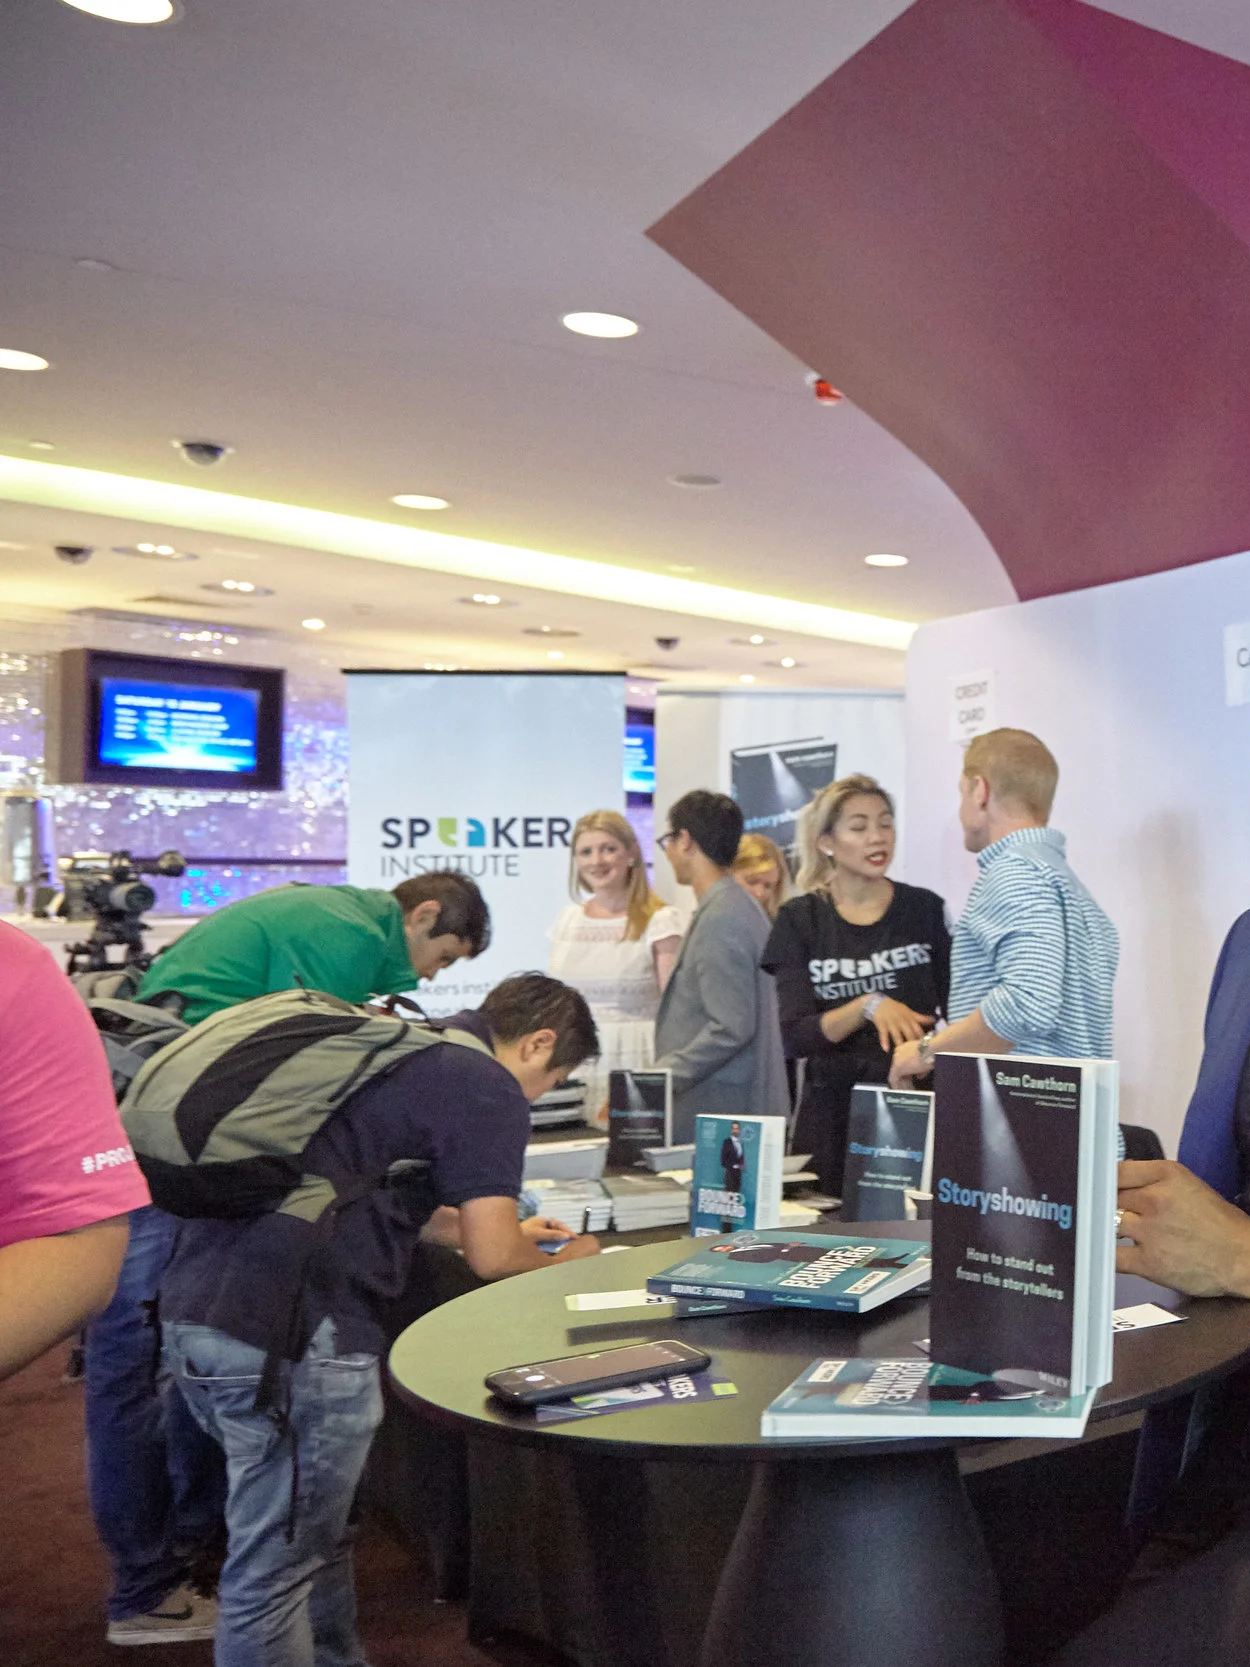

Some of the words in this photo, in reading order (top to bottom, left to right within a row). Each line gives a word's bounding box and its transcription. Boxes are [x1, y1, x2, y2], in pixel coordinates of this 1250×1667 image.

[381, 817, 571, 849] SPEAKER
[380, 853, 520, 877] INSTITUTE
[996, 1072, 1020, 1087] Sam
[1022, 1074, 1077, 1093] Cawthorn
[938, 1177, 1073, 1230] Storyshowing
[778, 1249, 848, 1287] BOUNCE
[800, 1245, 877, 1289] FORWARD
[966, 1247, 989, 1262] How
[991, 1253, 1003, 1265] to
[1004, 1256, 1034, 1272] stand
[1035, 1264, 1054, 1276] out
[956, 1266, 981, 1282] from
[983, 1272, 1000, 1286] the
[1002, 1278, 1064, 1300] storytellers
[667, 1373, 698, 1399] KERS
[883, 1362, 934, 1402] BOUNCE
[1038, 1371, 1068, 1388] WILEY
